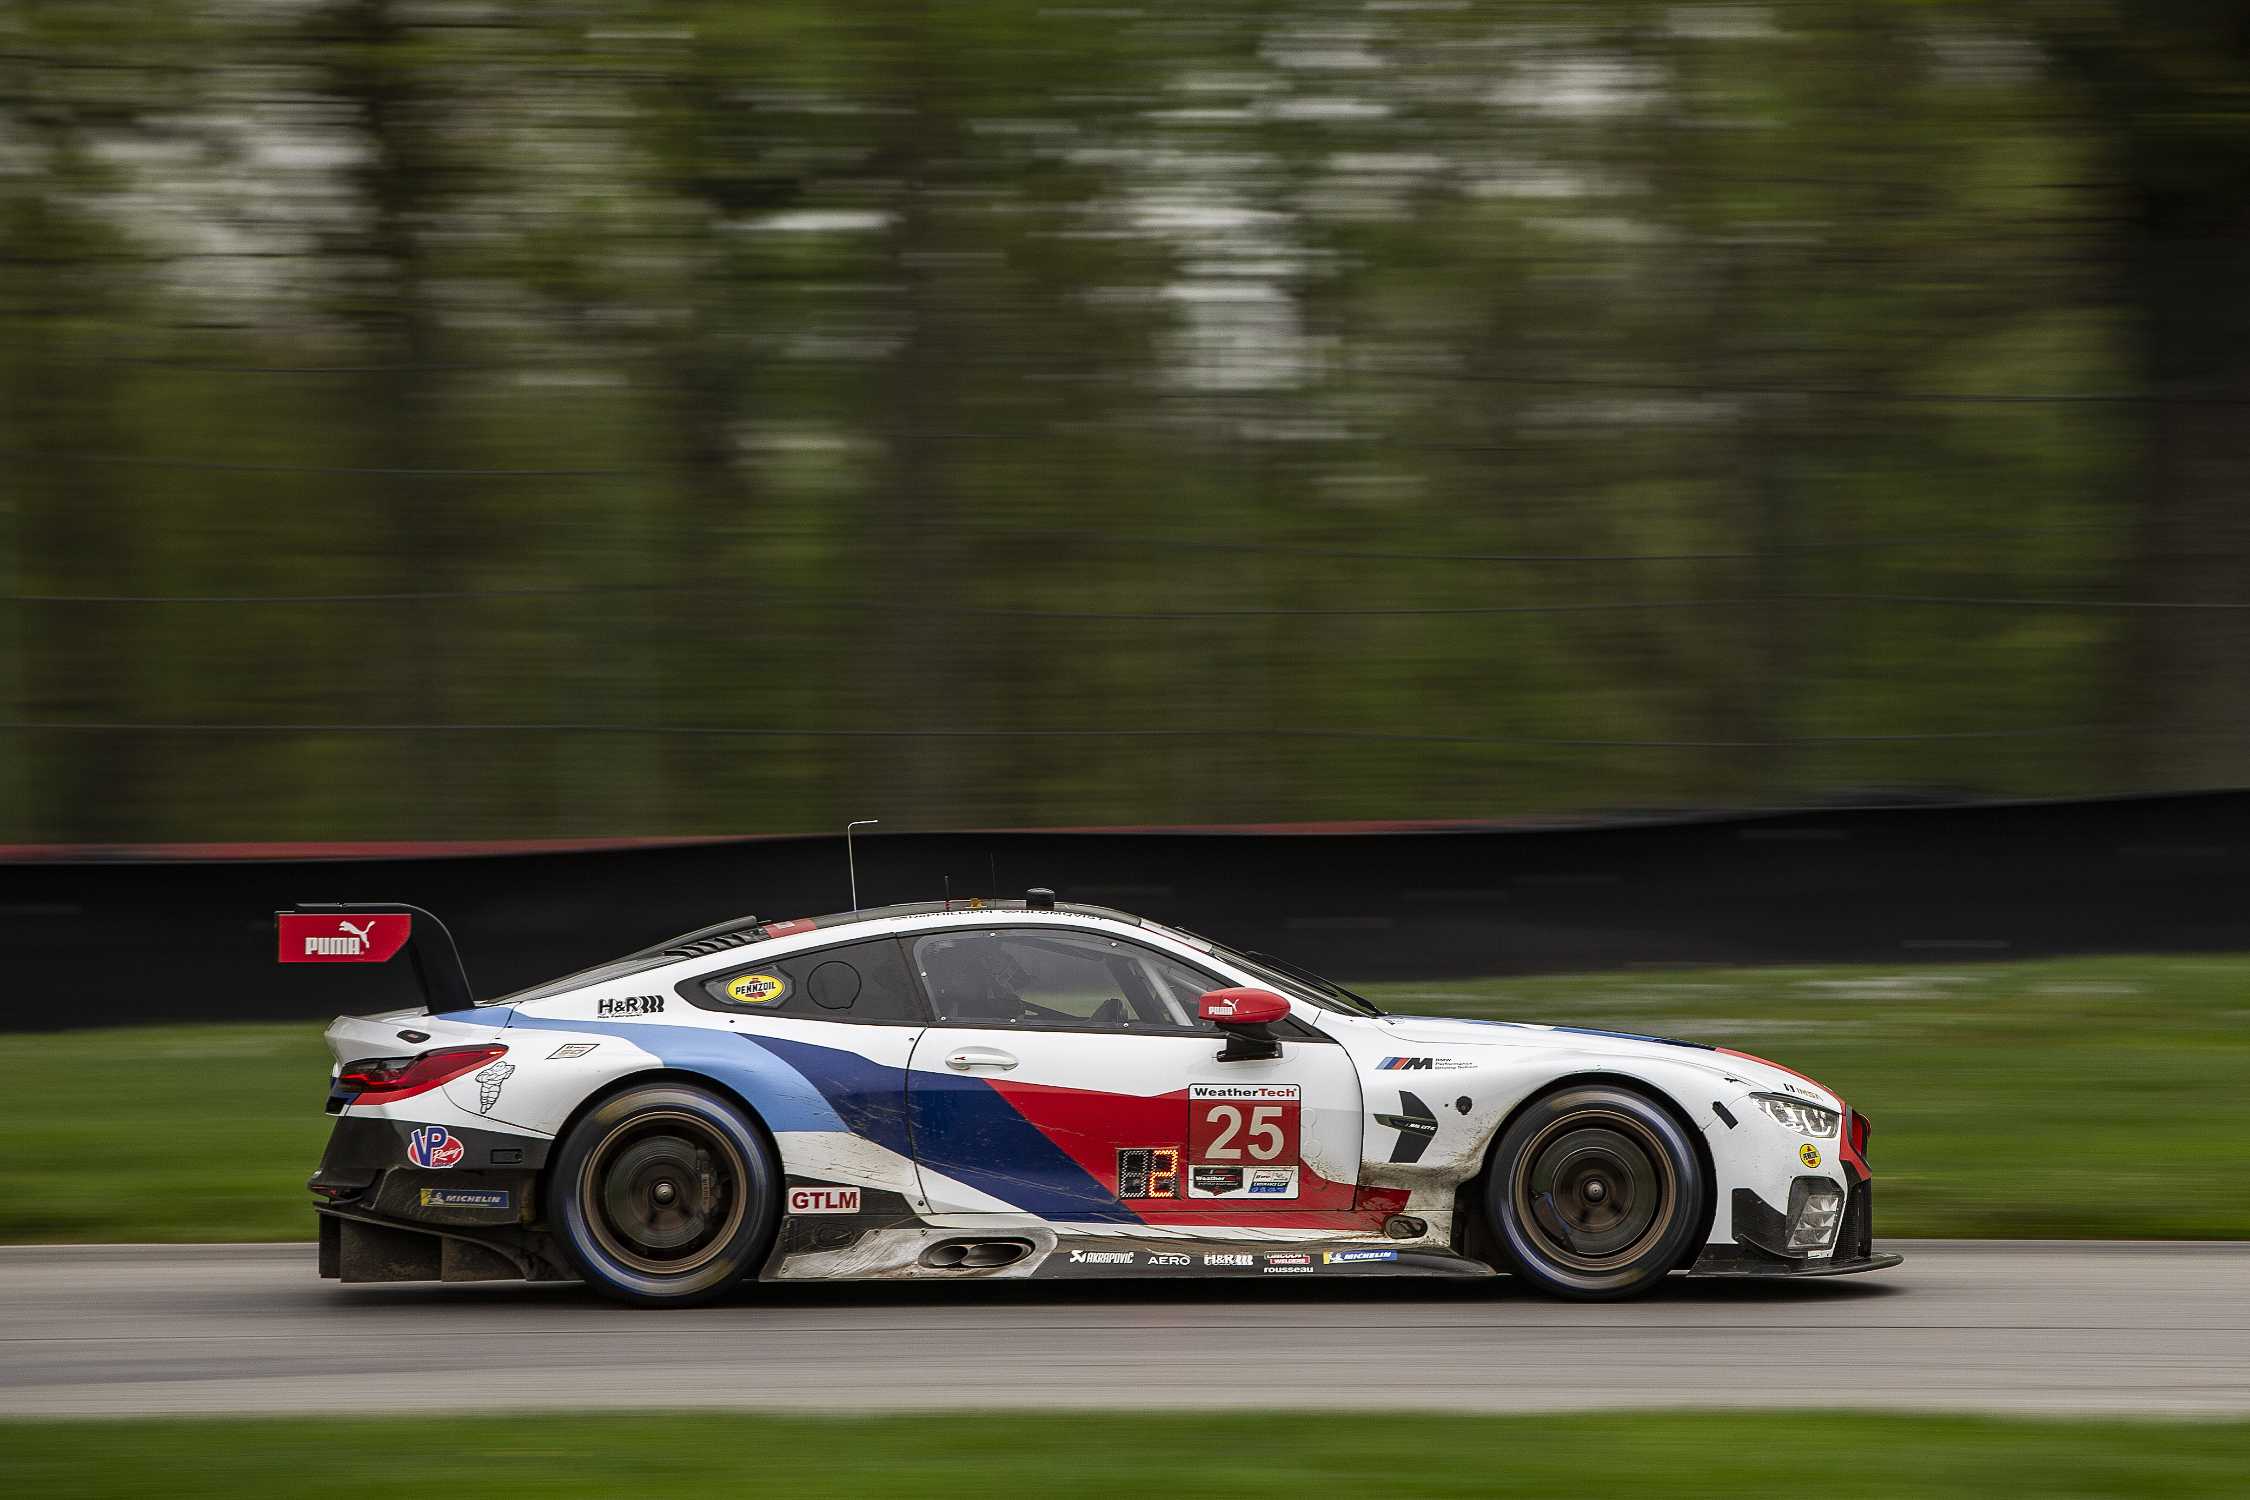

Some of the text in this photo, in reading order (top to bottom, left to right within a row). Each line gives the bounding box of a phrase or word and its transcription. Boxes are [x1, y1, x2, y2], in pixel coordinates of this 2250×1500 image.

[305, 937, 360, 955] PUMA
[735, 982, 777, 996] PENNZOIL
[598, 997, 640, 1015] H&R
[1194, 1087, 1296, 1097] WeatherTech
[1205, 1104, 1285, 1161] 25
[411, 1126, 449, 1168] VP
[446, 1195, 502, 1203] MICHELIN
[792, 1192, 858, 1209] GTLM
[1147, 1256, 1191, 1265] AERO
[1343, 1251, 1392, 1260] MICHELIN
